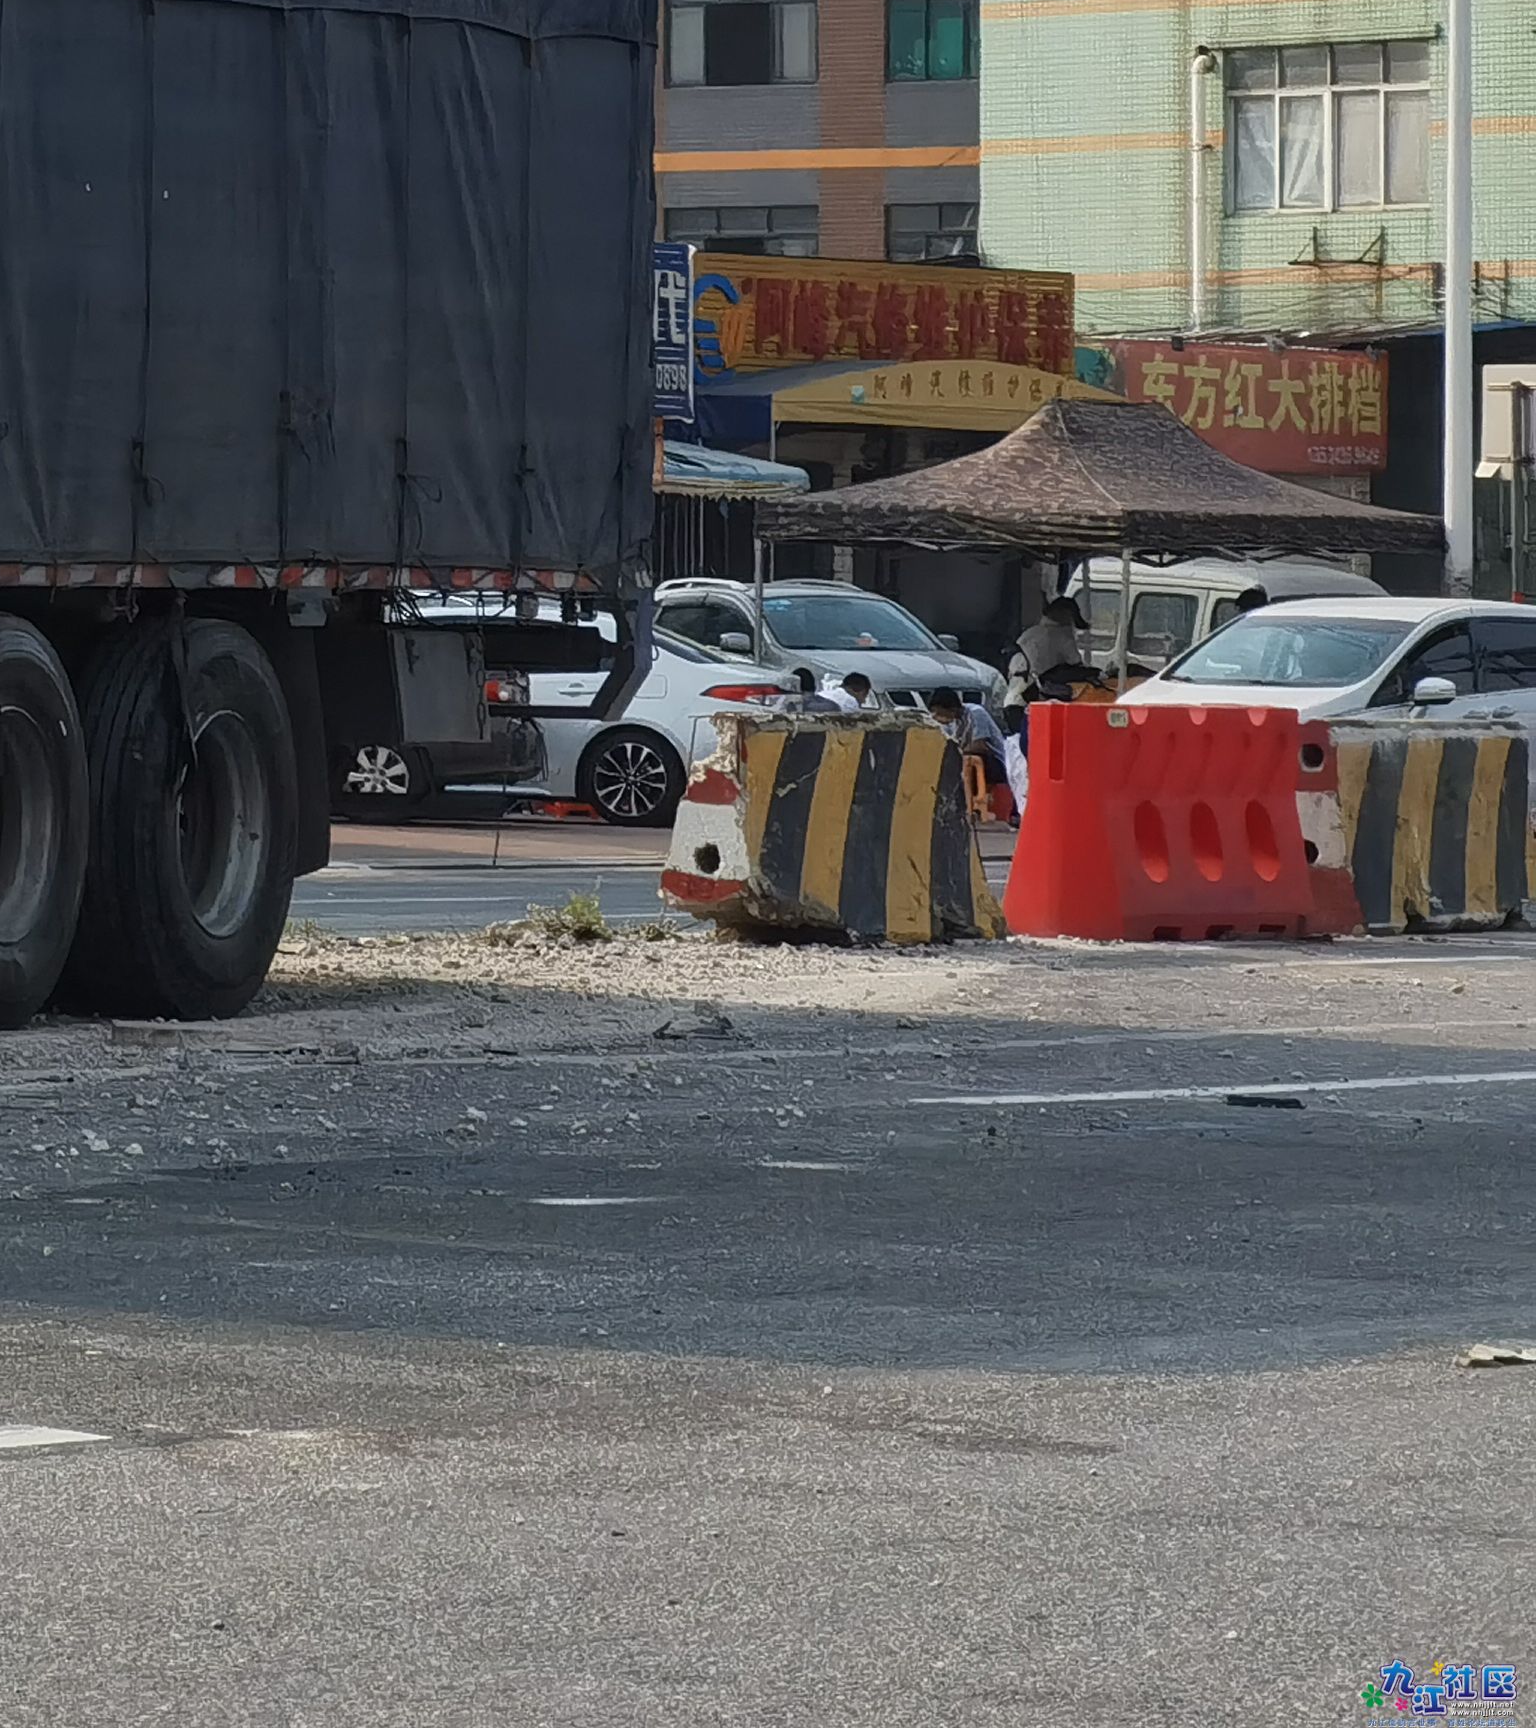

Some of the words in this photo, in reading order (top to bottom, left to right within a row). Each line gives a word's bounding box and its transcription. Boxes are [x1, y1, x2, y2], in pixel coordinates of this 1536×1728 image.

[1141, 353, 1381, 436] 东方红大排档
